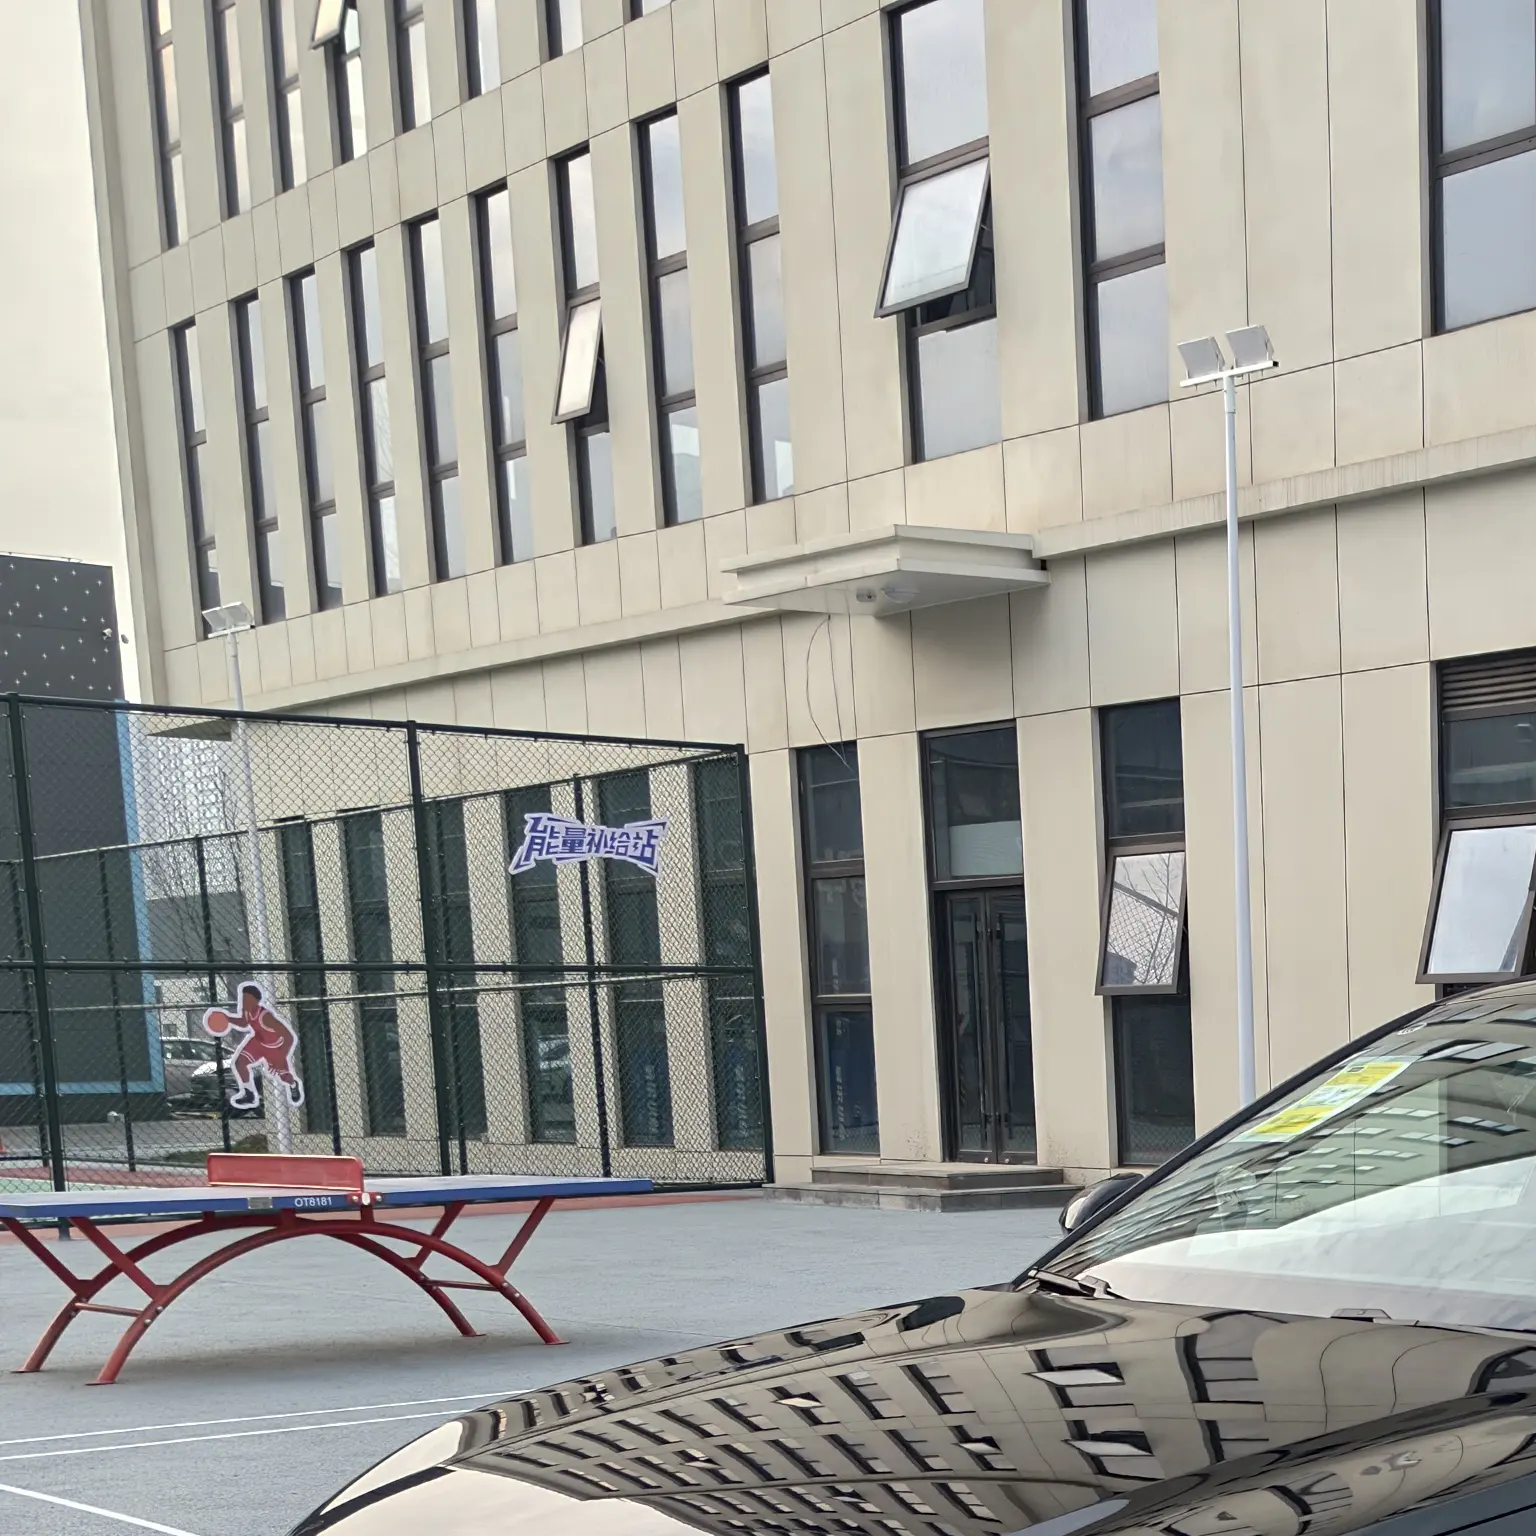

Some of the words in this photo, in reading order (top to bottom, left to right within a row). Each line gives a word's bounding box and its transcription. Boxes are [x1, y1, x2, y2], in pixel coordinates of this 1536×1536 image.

[521, 814, 661, 869] 能量补给站
